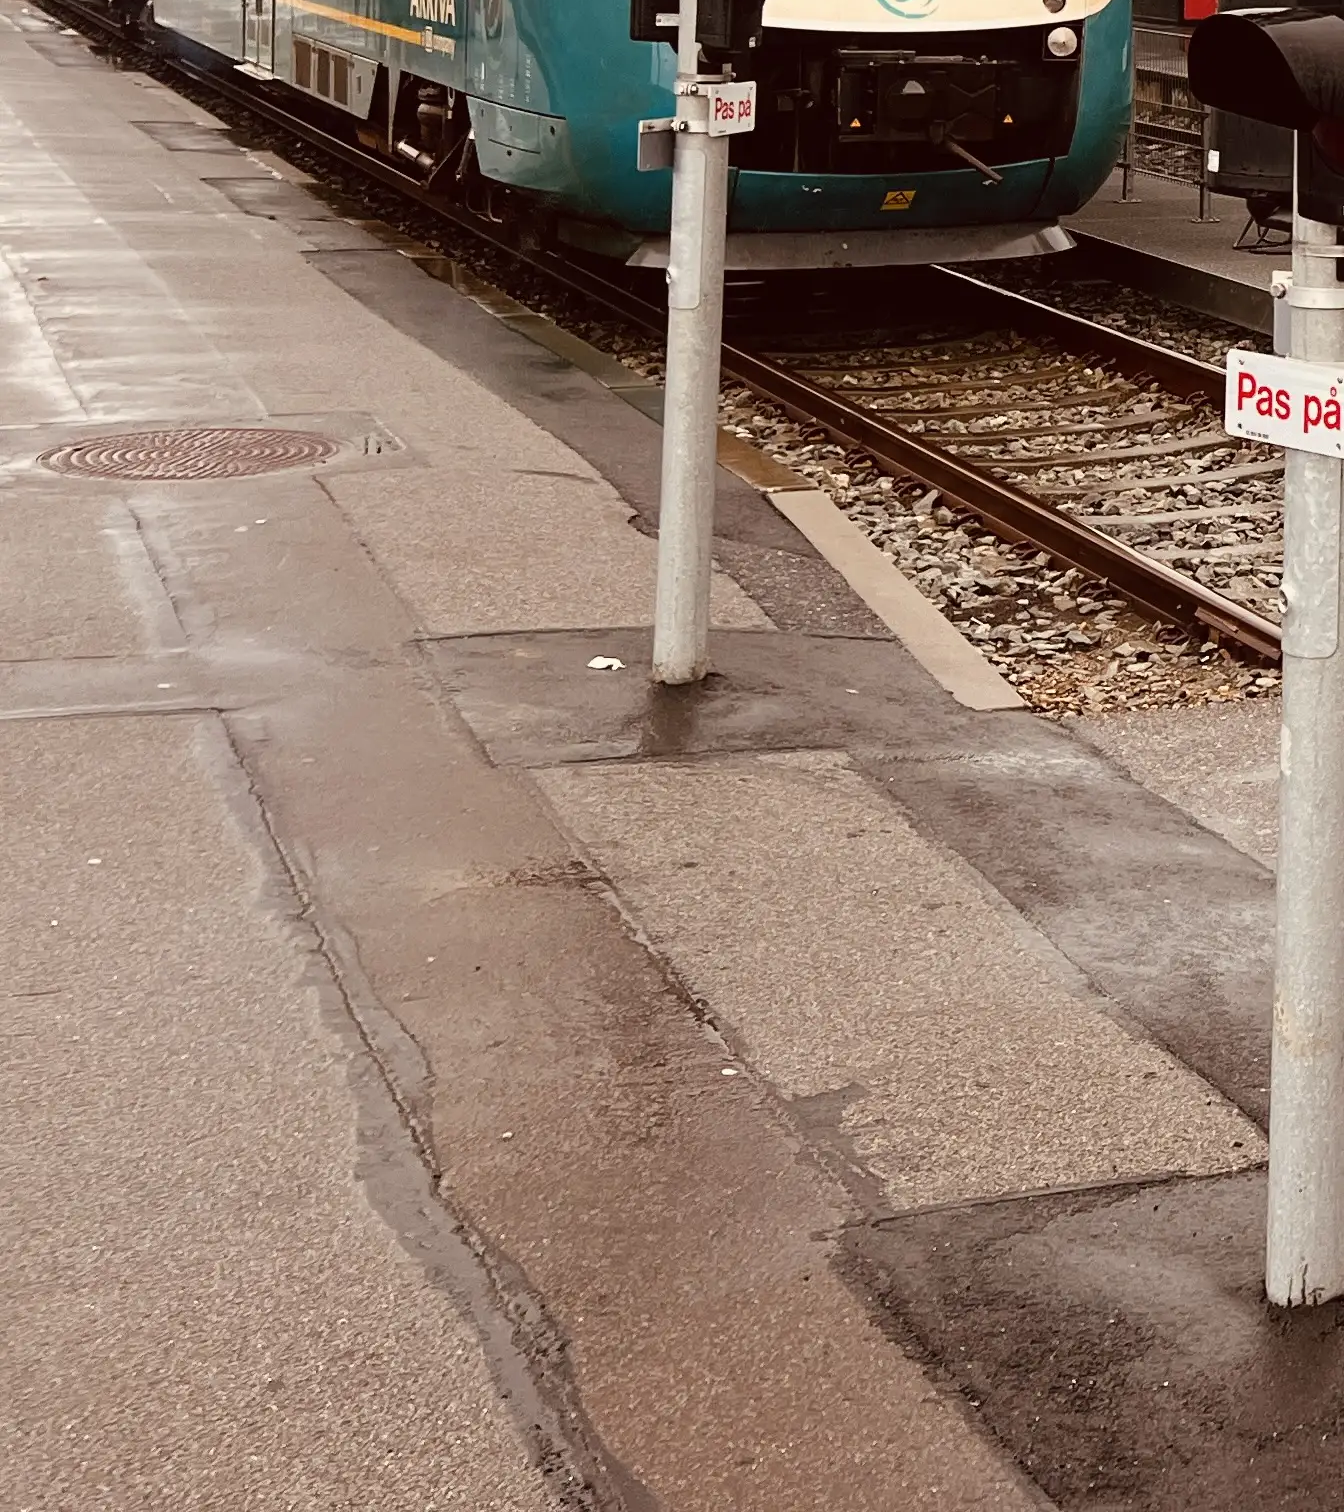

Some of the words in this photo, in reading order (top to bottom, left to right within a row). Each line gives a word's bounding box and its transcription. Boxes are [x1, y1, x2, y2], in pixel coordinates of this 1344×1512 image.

[714, 96, 735, 121] Pas
[737, 91, 752, 123] på
[1237, 371, 1291, 420] Pas
[1303, 386, 1341, 434] på
